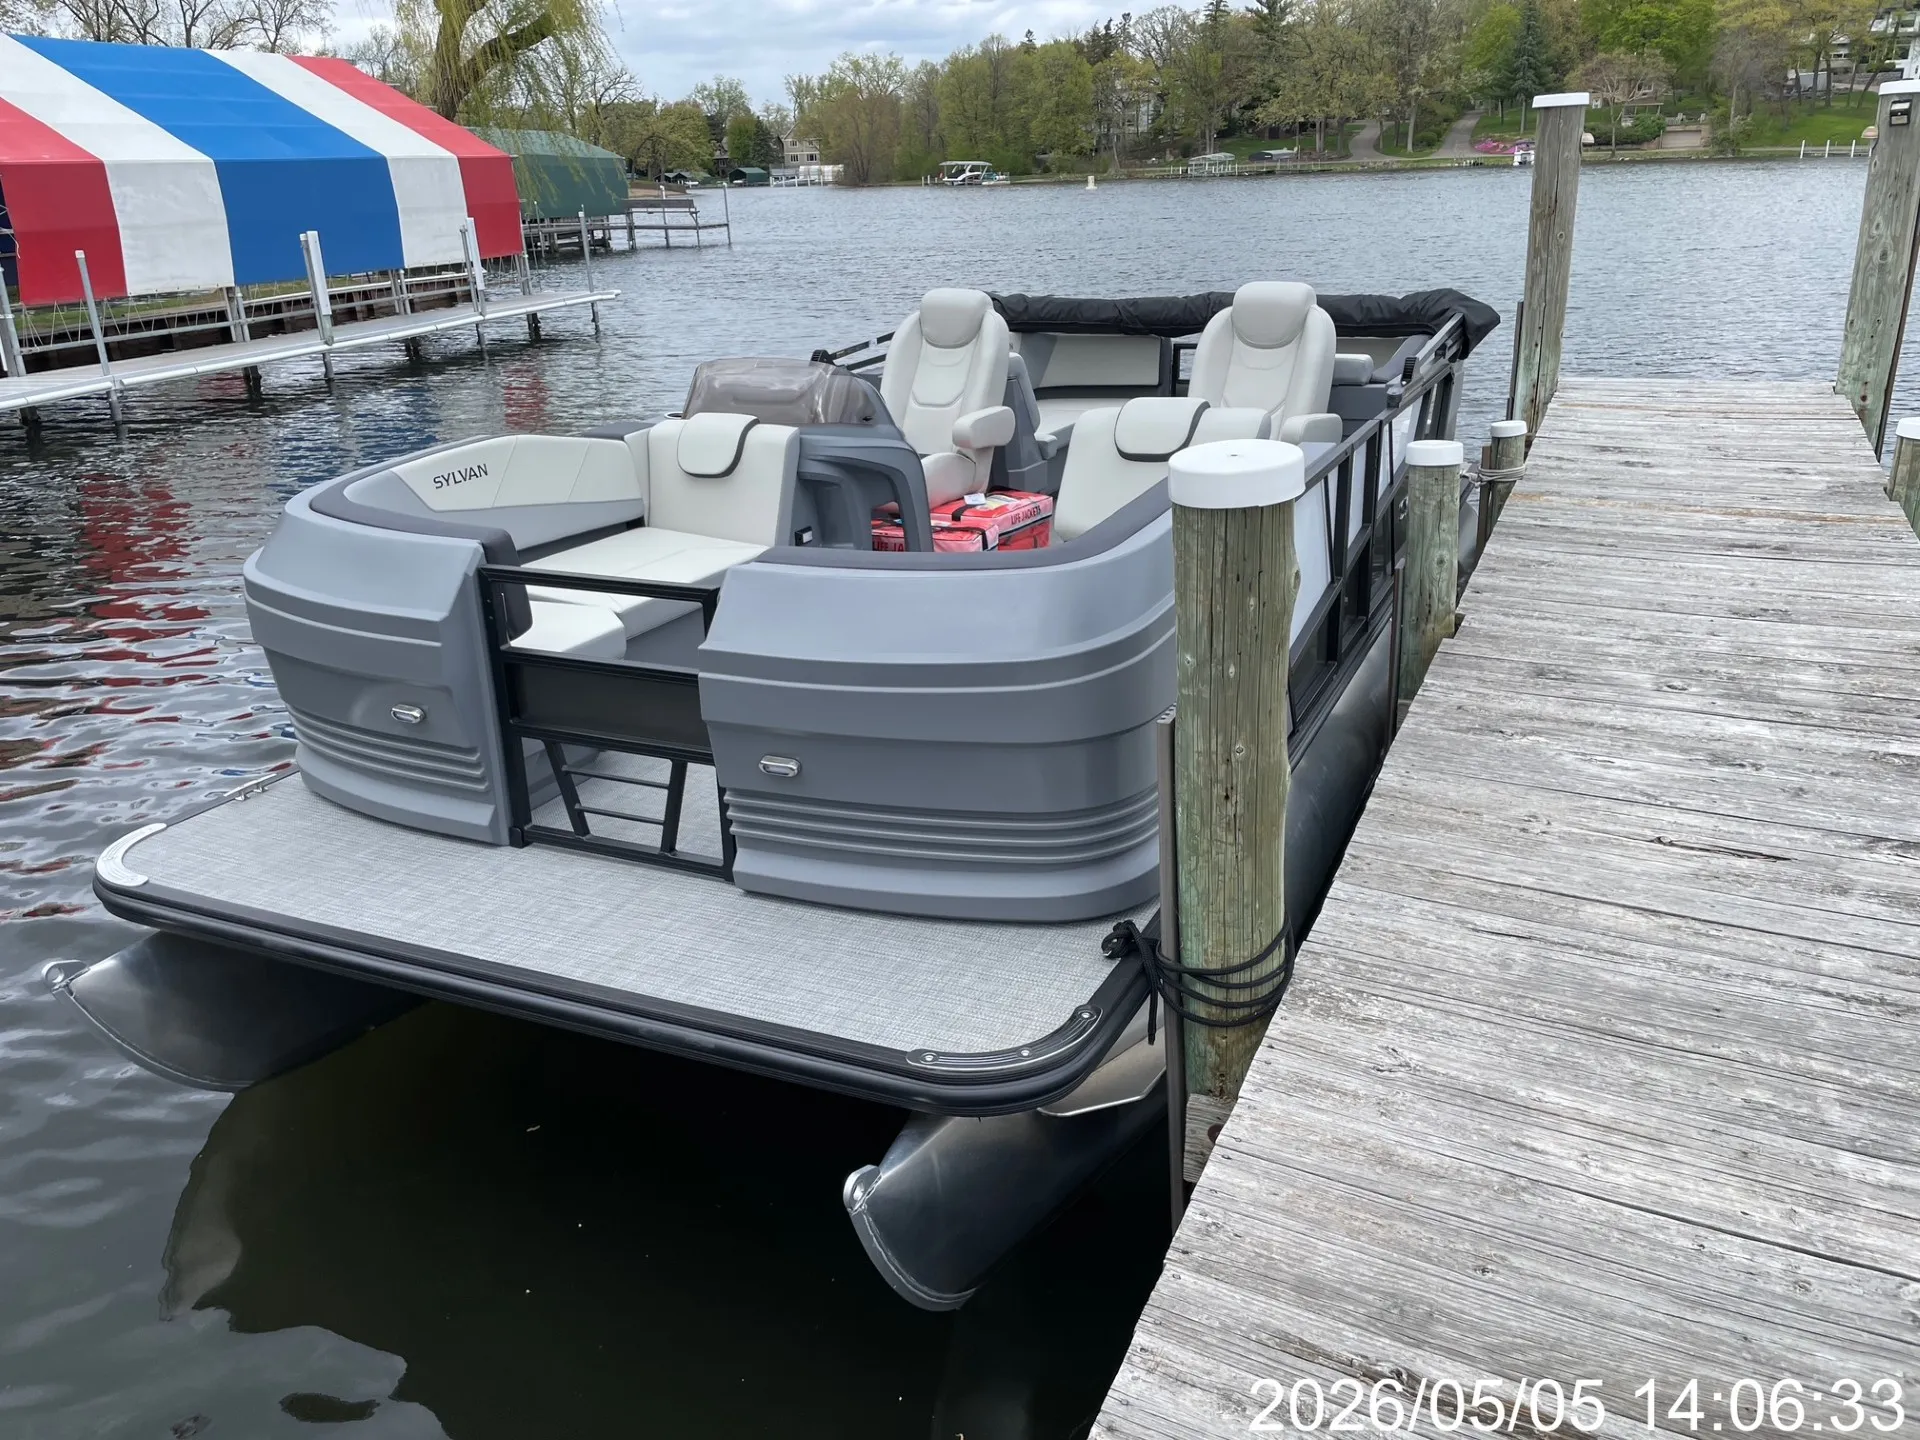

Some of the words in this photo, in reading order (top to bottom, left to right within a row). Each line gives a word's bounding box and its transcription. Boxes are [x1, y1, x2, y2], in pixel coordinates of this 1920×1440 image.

[433, 463, 489, 490] SYLVAN
[1010, 513, 1021, 525] LIFE
[1021, 505, 1041, 521] JACKETS
